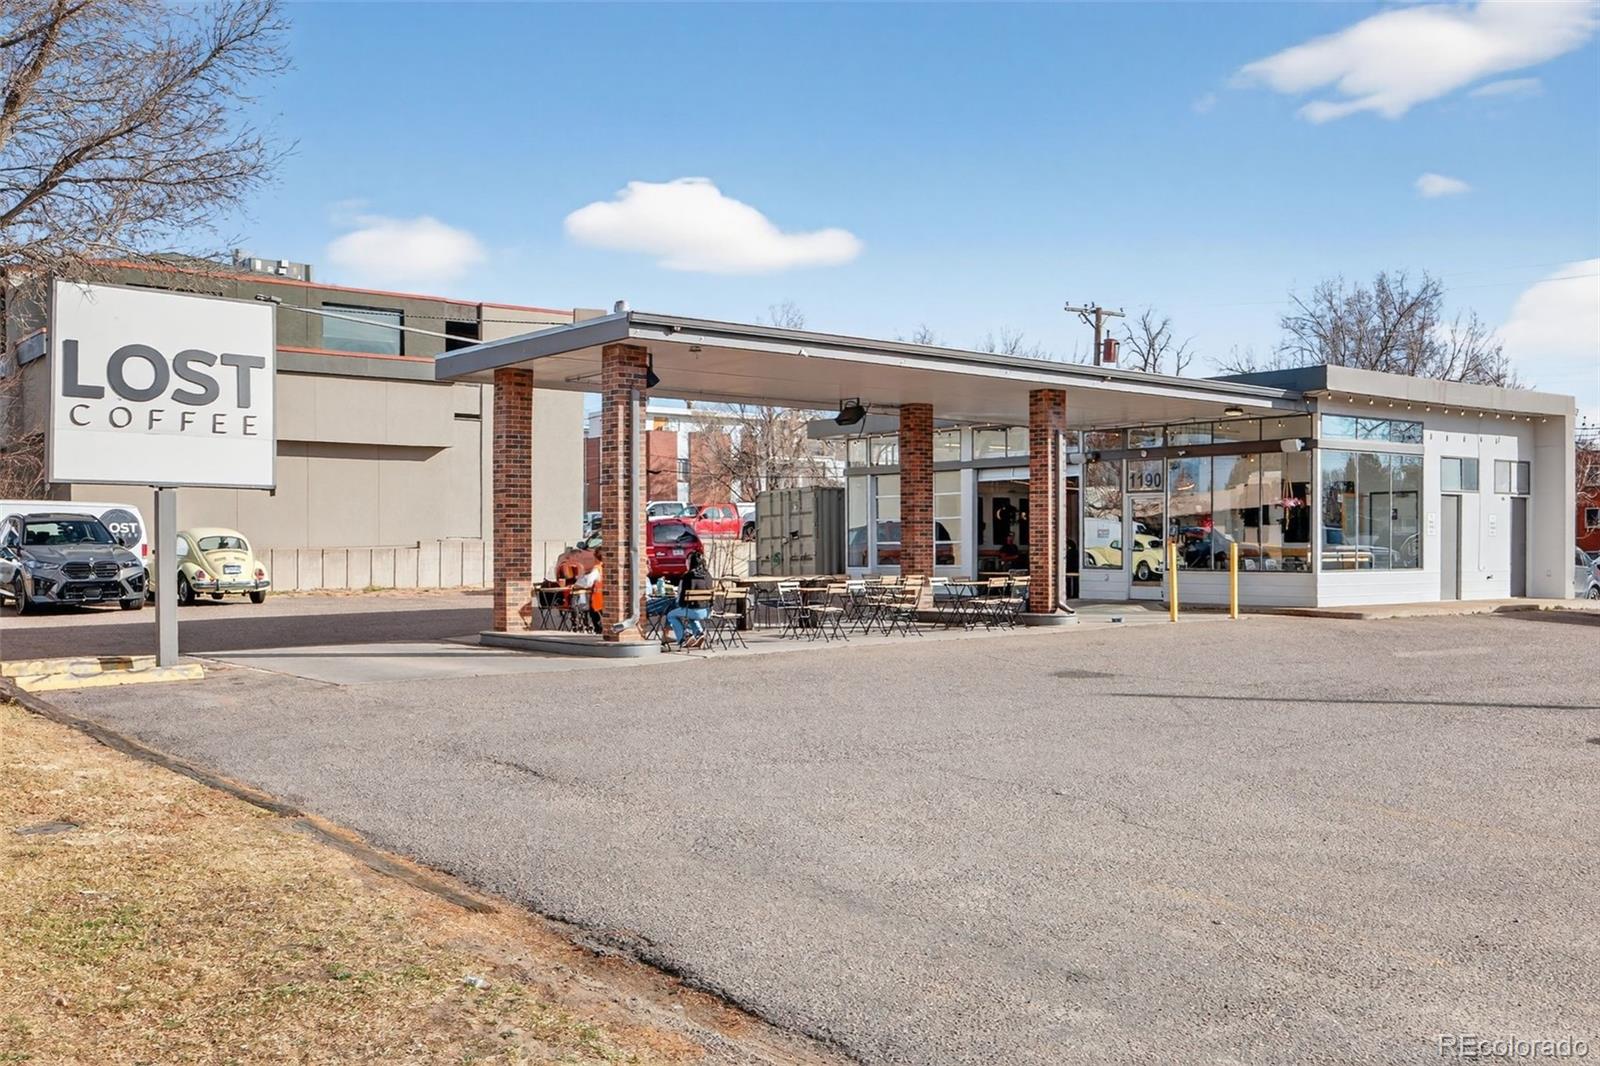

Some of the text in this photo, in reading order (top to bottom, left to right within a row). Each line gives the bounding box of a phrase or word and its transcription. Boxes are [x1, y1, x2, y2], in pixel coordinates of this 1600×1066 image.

[62, 339, 266, 409] LOST
[69, 404, 257, 436] COFFEE
[1129, 472, 1162, 488] 1190
[108, 522, 138, 533] OST
